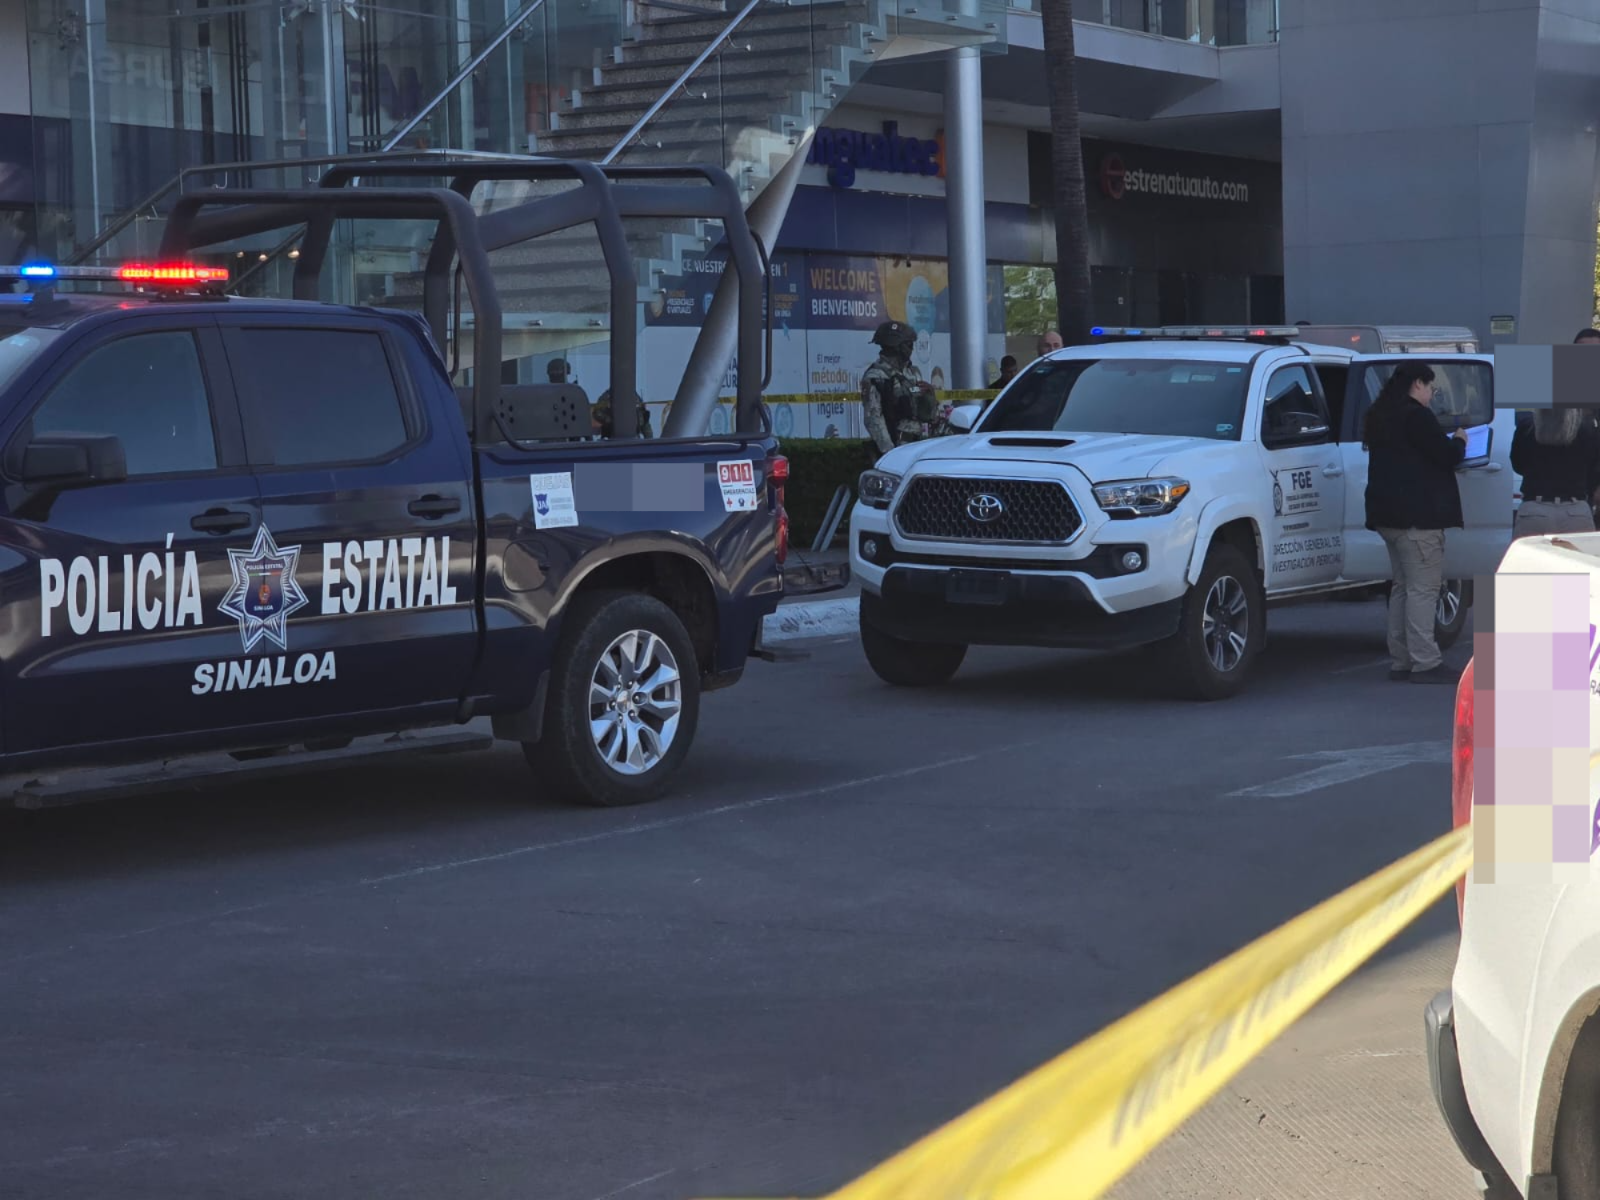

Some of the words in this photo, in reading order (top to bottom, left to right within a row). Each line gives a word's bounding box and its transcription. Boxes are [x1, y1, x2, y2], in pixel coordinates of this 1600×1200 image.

[1123, 168, 1249, 202] estrenatuauto.com
[810, 268, 876, 292] WELCOME
[811, 299, 877, 317] BIENVENIDOS
[817, 354, 823, 363] El
[824, 353, 841, 366] mejor
[811, 367, 848, 384] método
[720, 465, 751, 481] 911
[1291, 471, 1312, 490] FGE
[1305, 537, 1331, 551] GENERAL
[1332, 536, 1341, 547] DE
[40, 532, 203, 637] POLICÍA
[321, 536, 457, 615] ESTATAL
[192, 651, 336, 695] SINALOA
